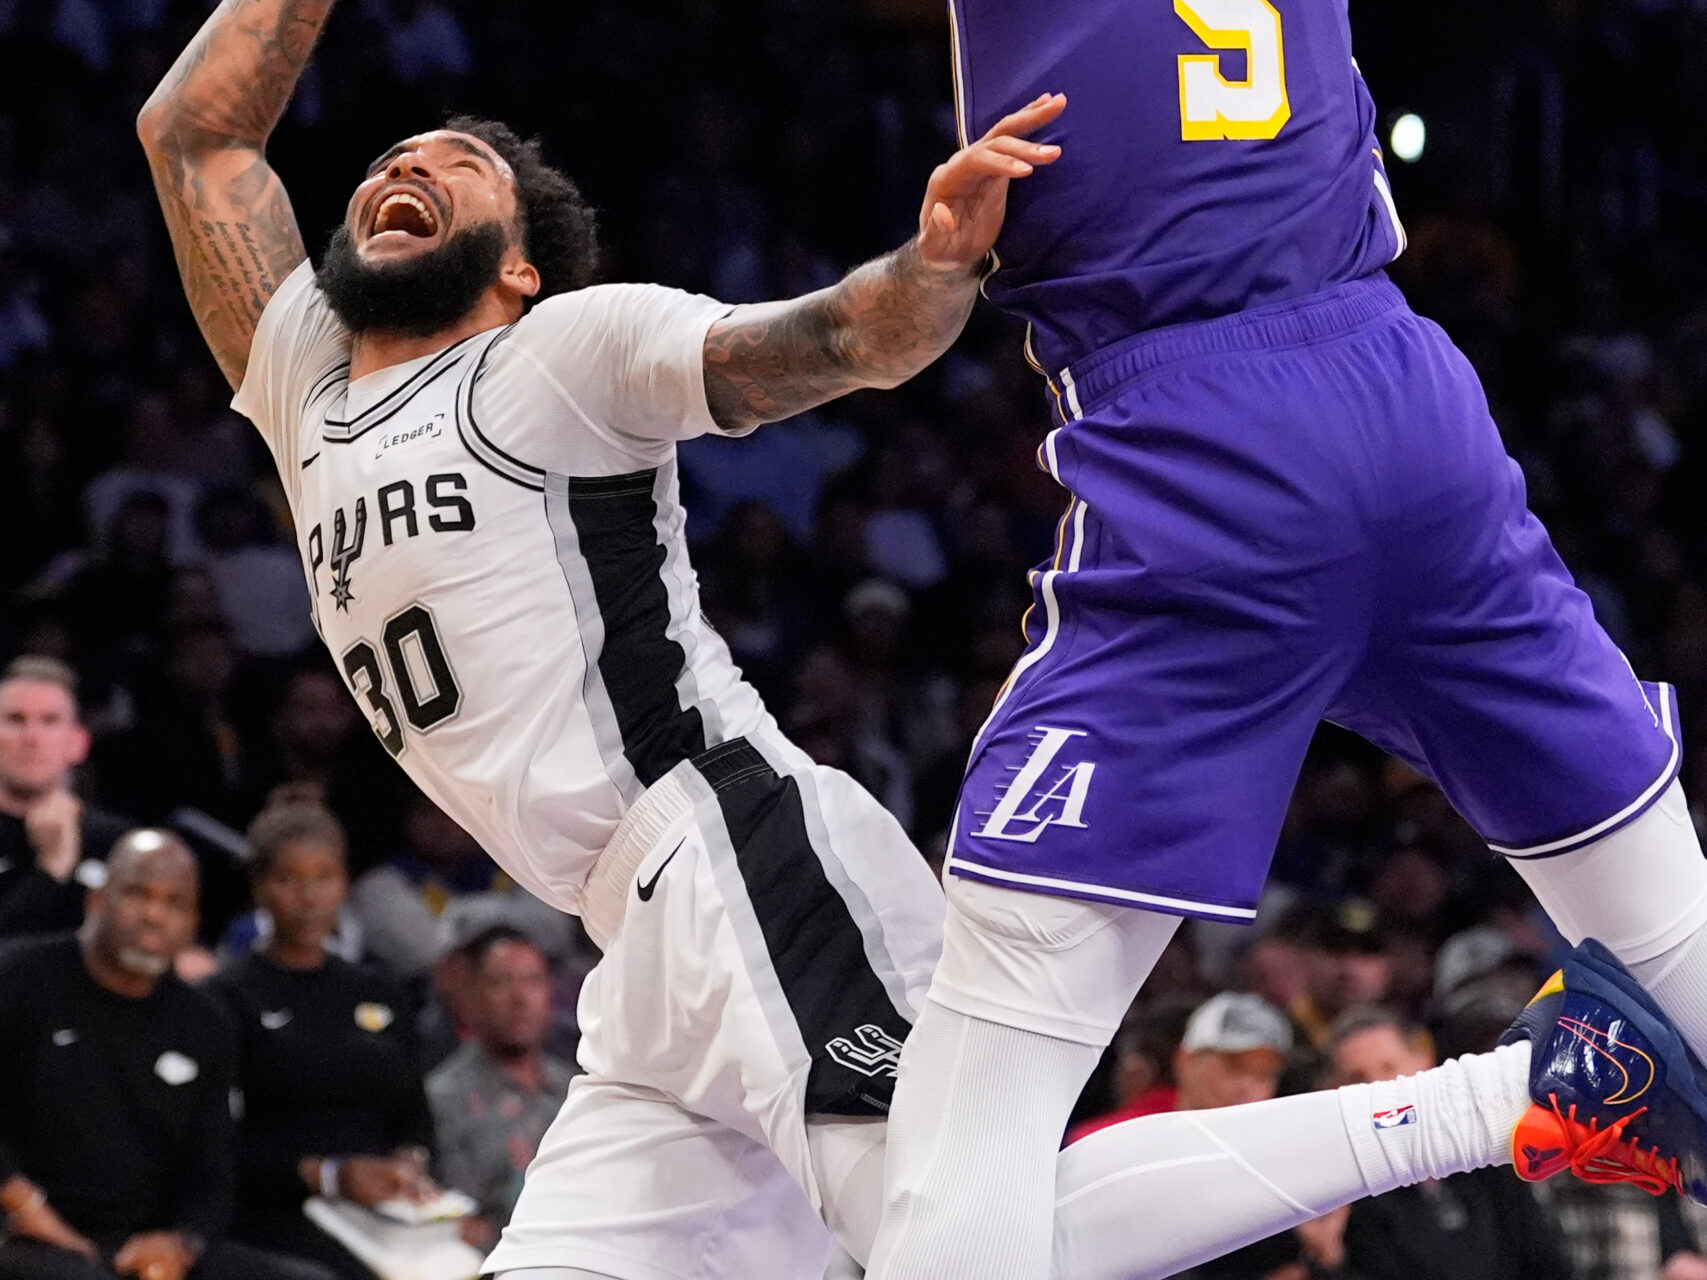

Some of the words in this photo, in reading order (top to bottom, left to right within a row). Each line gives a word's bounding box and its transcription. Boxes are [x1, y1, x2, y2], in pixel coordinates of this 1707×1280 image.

[383, 422, 434, 449] LEDGER
[309, 473, 475, 614] PURS
[341, 600, 465, 761] 30
[970, 726, 1096, 843] LA
